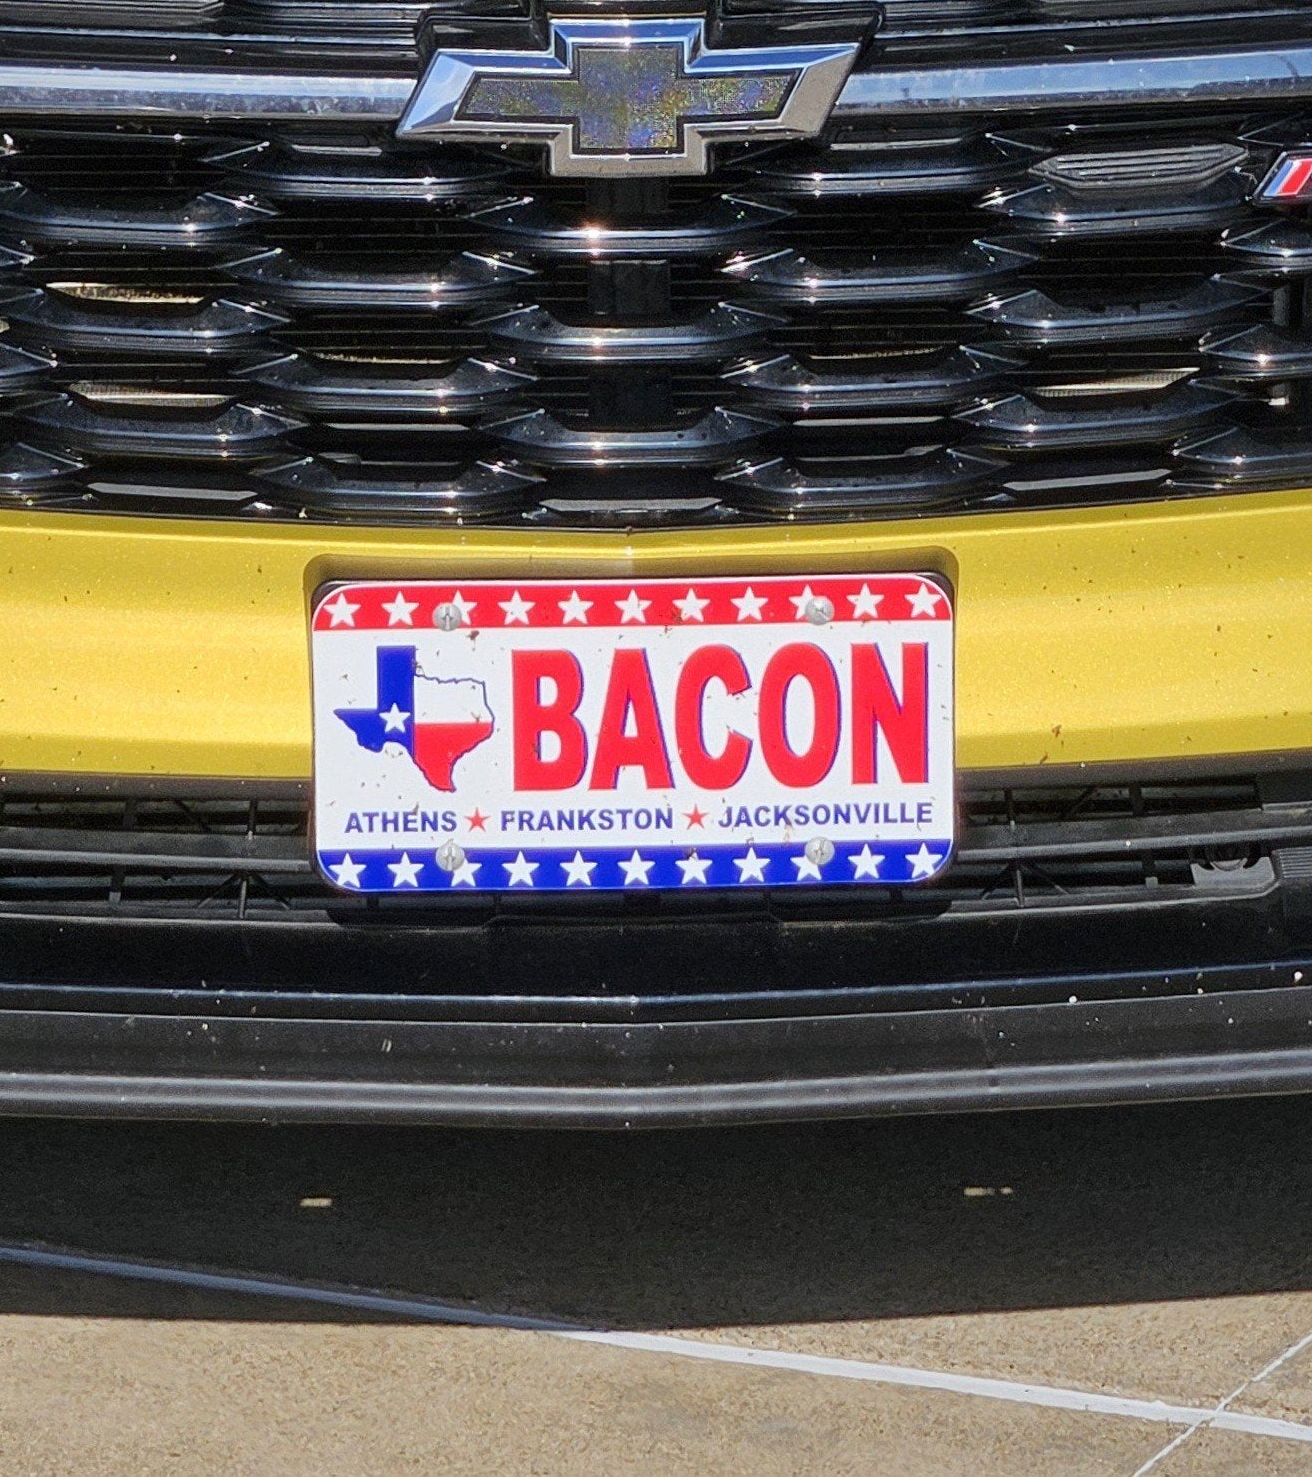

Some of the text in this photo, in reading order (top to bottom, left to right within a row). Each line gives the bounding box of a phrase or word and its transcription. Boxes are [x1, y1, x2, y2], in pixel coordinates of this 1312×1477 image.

[512, 641, 929, 792] BACON
[344, 802, 933, 834] ATHENS FRANKSTON JACKSONVILLE
